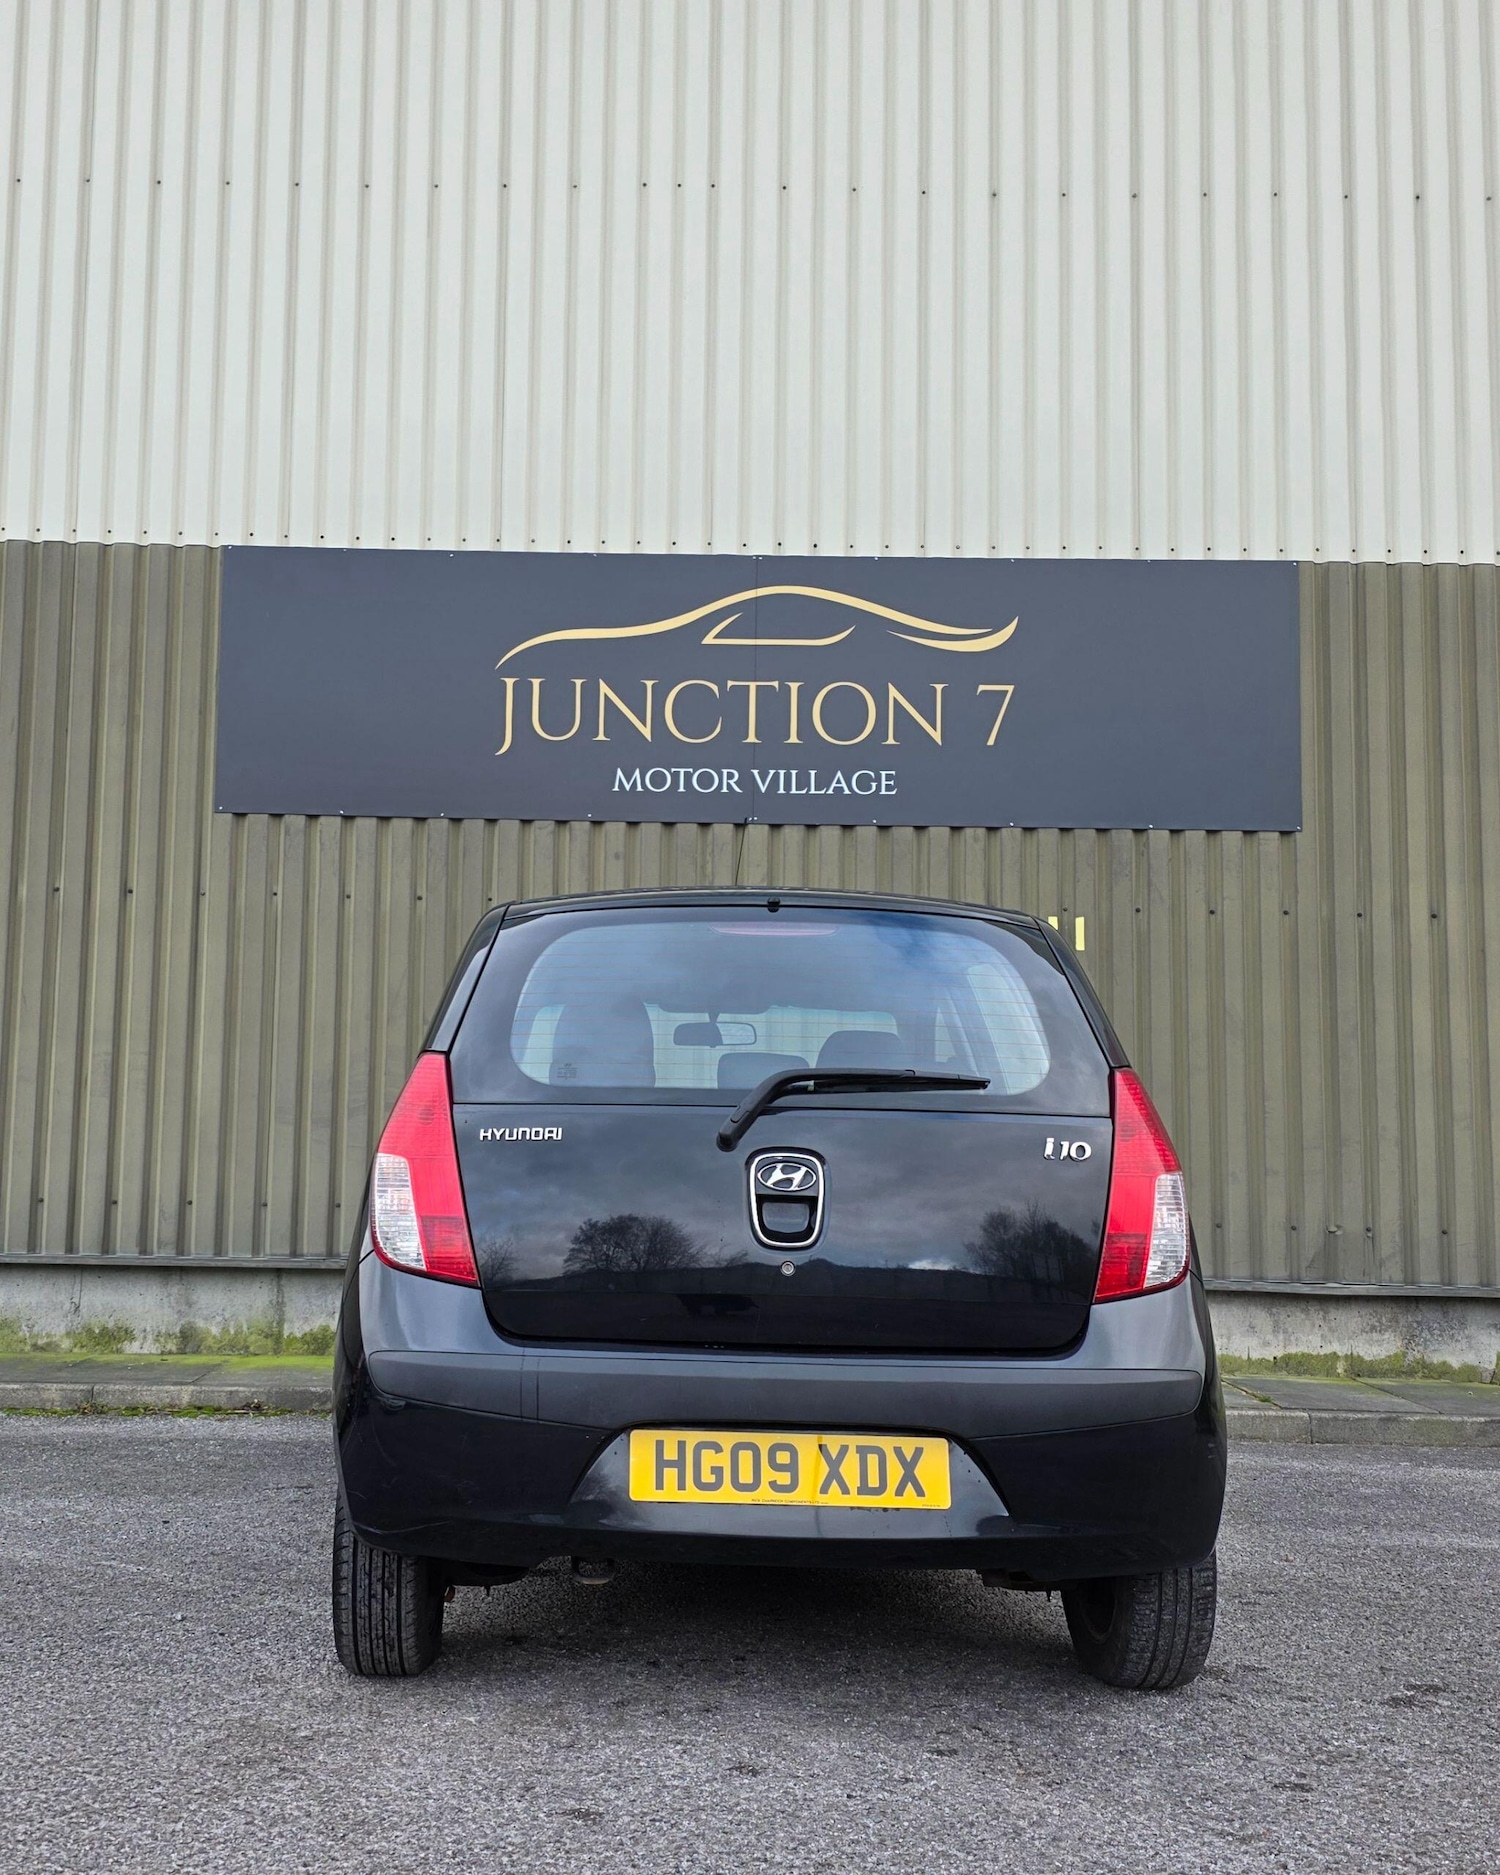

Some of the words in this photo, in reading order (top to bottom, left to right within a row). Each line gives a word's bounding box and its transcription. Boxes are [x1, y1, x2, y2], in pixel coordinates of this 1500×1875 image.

[495, 677, 949, 755] JUNCTION
[976, 684, 1016, 746] 7
[612, 767, 743, 793] MOTOR
[750, 769, 898, 796] VILLAGE
[479, 1127, 563, 1141] HYUNDAI
[655, 1439, 799, 1493] HG09
[818, 1443, 927, 1498] XDX
